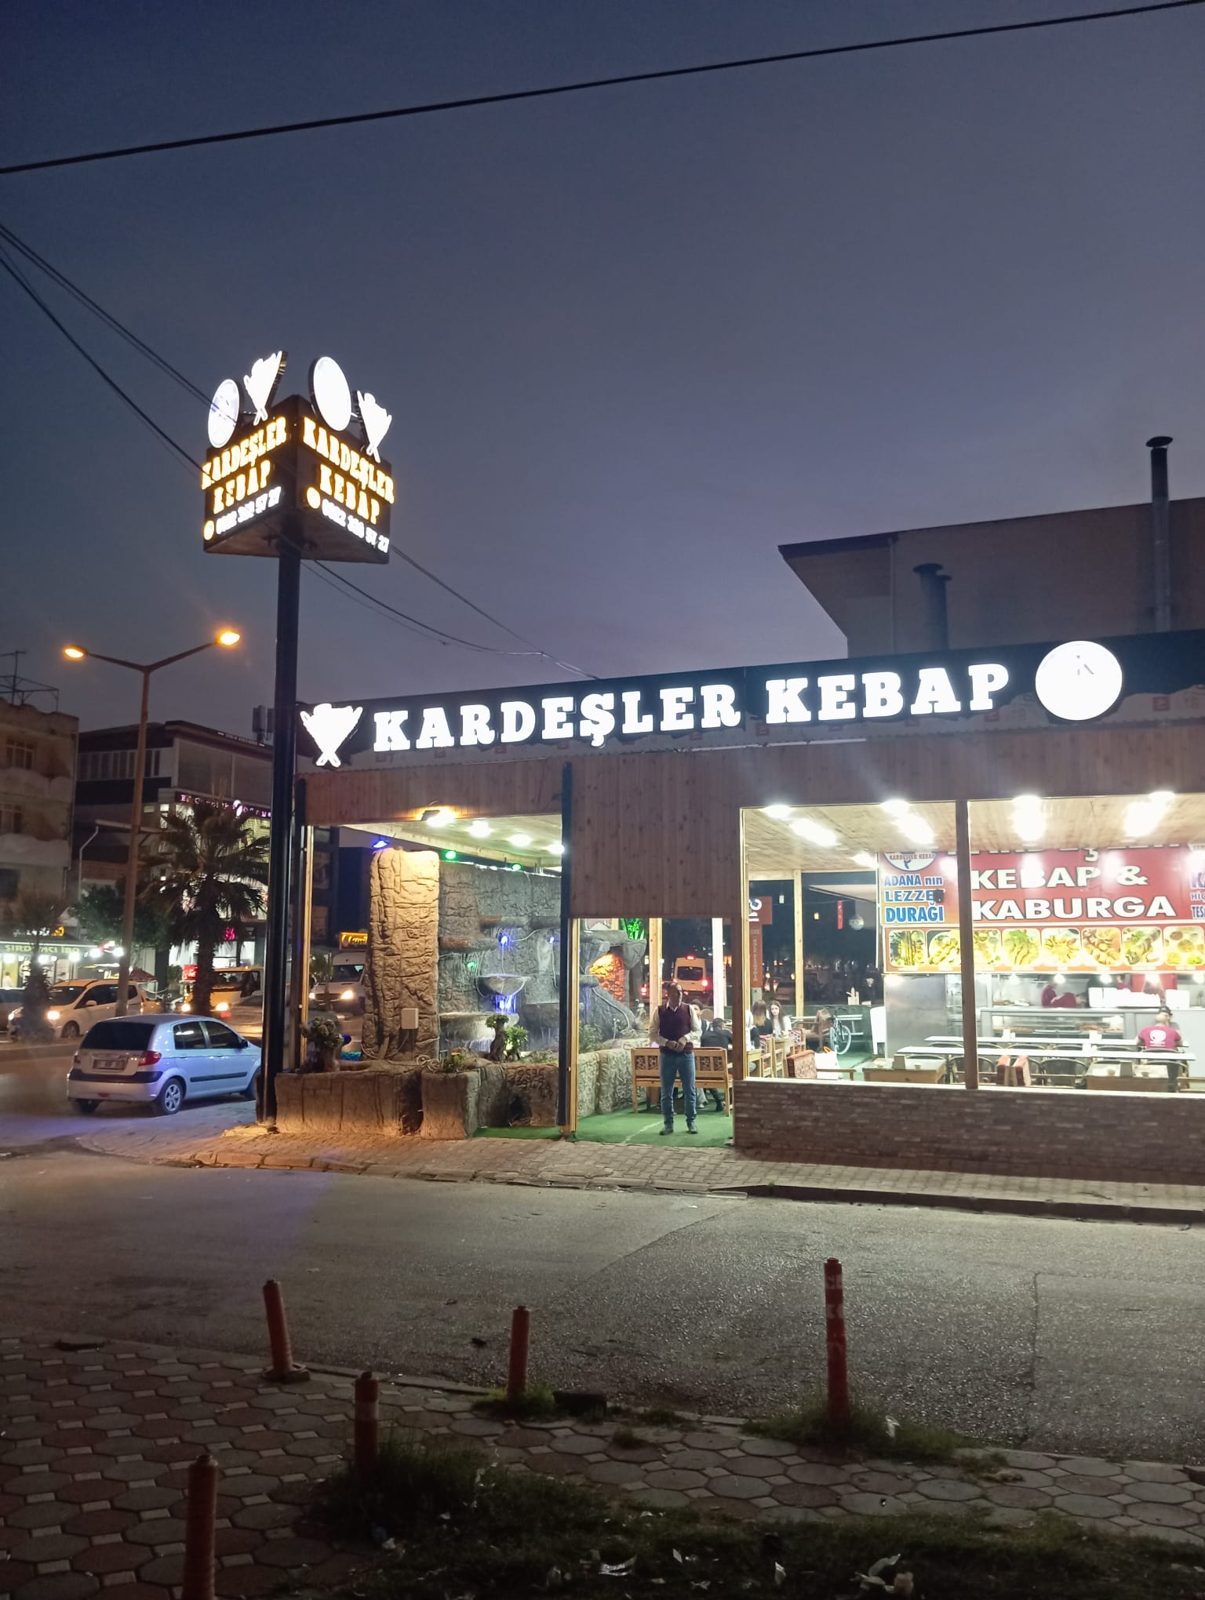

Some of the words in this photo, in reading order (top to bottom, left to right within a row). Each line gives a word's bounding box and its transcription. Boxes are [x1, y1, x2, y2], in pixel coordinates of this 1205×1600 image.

[201, 416, 287, 490] KARDEŞLER
[303, 416, 395, 504] KARDEŞLER
[320, 463, 380, 525] KEBAP
[373, 684, 742, 752] KARDEŞLER
[765, 663, 1010, 725] KEBAP
[885, 875, 921, 886] ADANA
[971, 866, 1100, 890] KEBAP
[1116, 864, 1148, 886] &
[885, 889, 945, 903] LEZZE
[973, 895, 1178, 921] KABURGA
[885, 902, 944, 922] DURAĞI
